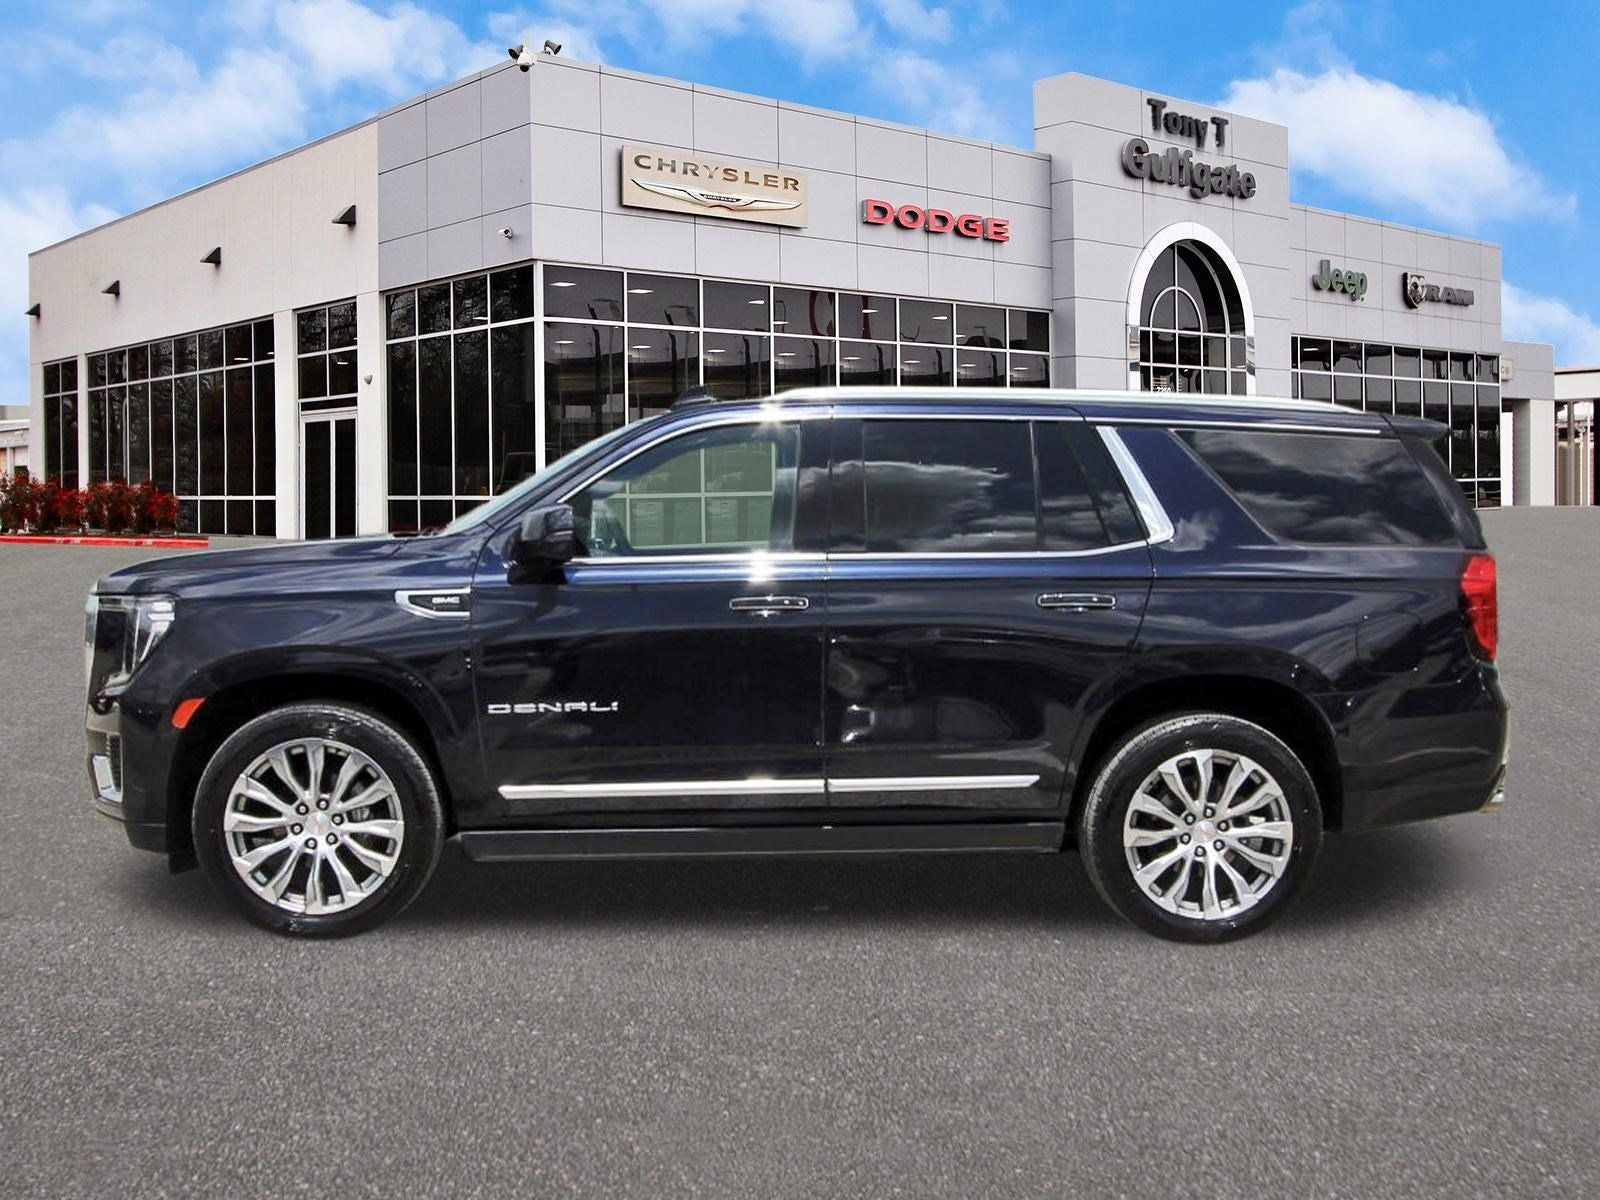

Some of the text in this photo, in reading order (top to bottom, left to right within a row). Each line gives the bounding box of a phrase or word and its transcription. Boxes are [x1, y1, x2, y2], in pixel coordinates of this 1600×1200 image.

[1146, 98, 1229, 147] Tony T
[633, 153, 801, 192] CHRYSLER
[1121, 138, 1256, 199] Gulfgate
[862, 198, 1010, 243] DODGE
[1312, 259, 1367, 301] Jeep
[1424, 284, 1475, 306] RAM
[431, 596, 460, 605] GMC
[487, 701, 619, 715] DENALI
